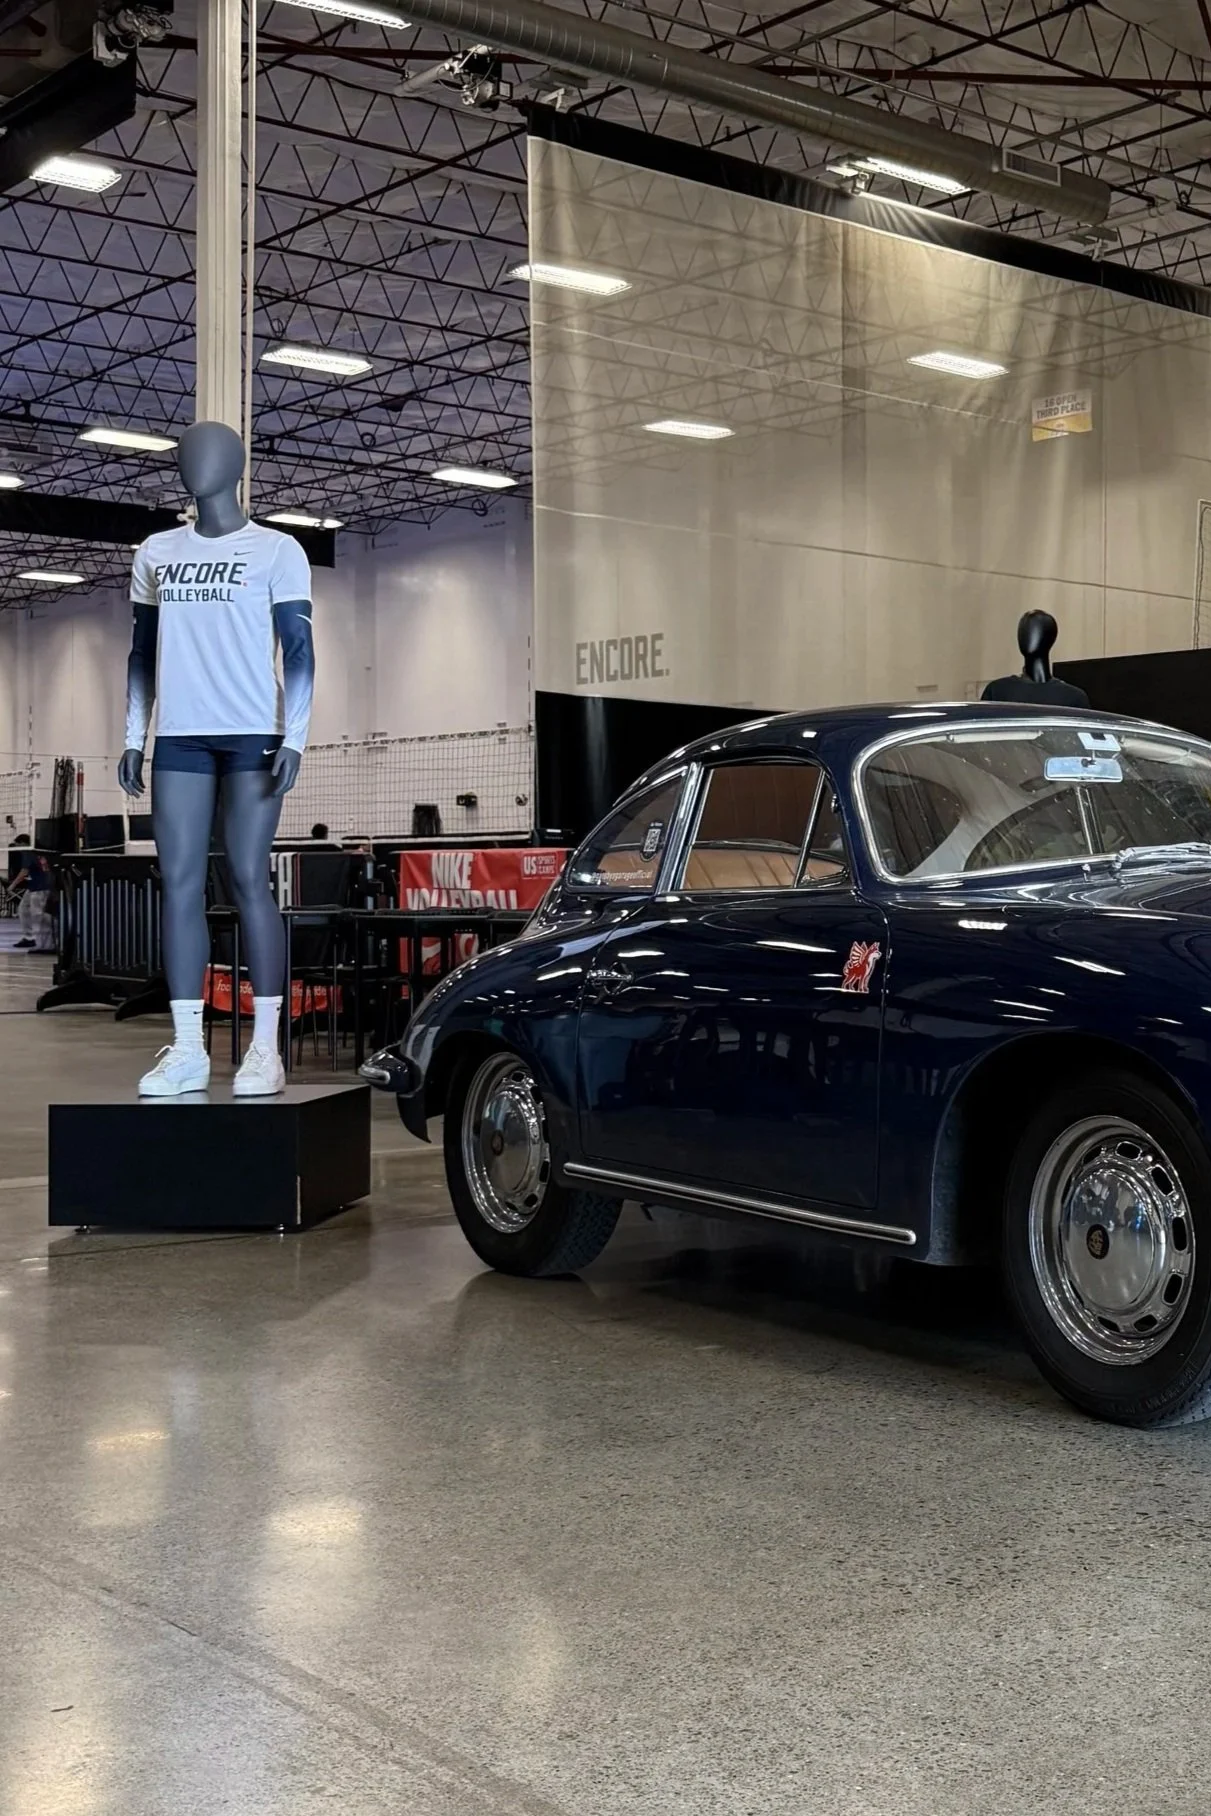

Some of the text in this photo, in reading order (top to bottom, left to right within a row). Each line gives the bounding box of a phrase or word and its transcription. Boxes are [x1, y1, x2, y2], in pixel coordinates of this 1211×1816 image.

[1036, 401, 1086, 419] THIRD PLACE
[158, 588, 235, 603] VOLLEYBALL
[431, 852, 474, 889] NIKE
[523, 855, 537, 875] US
